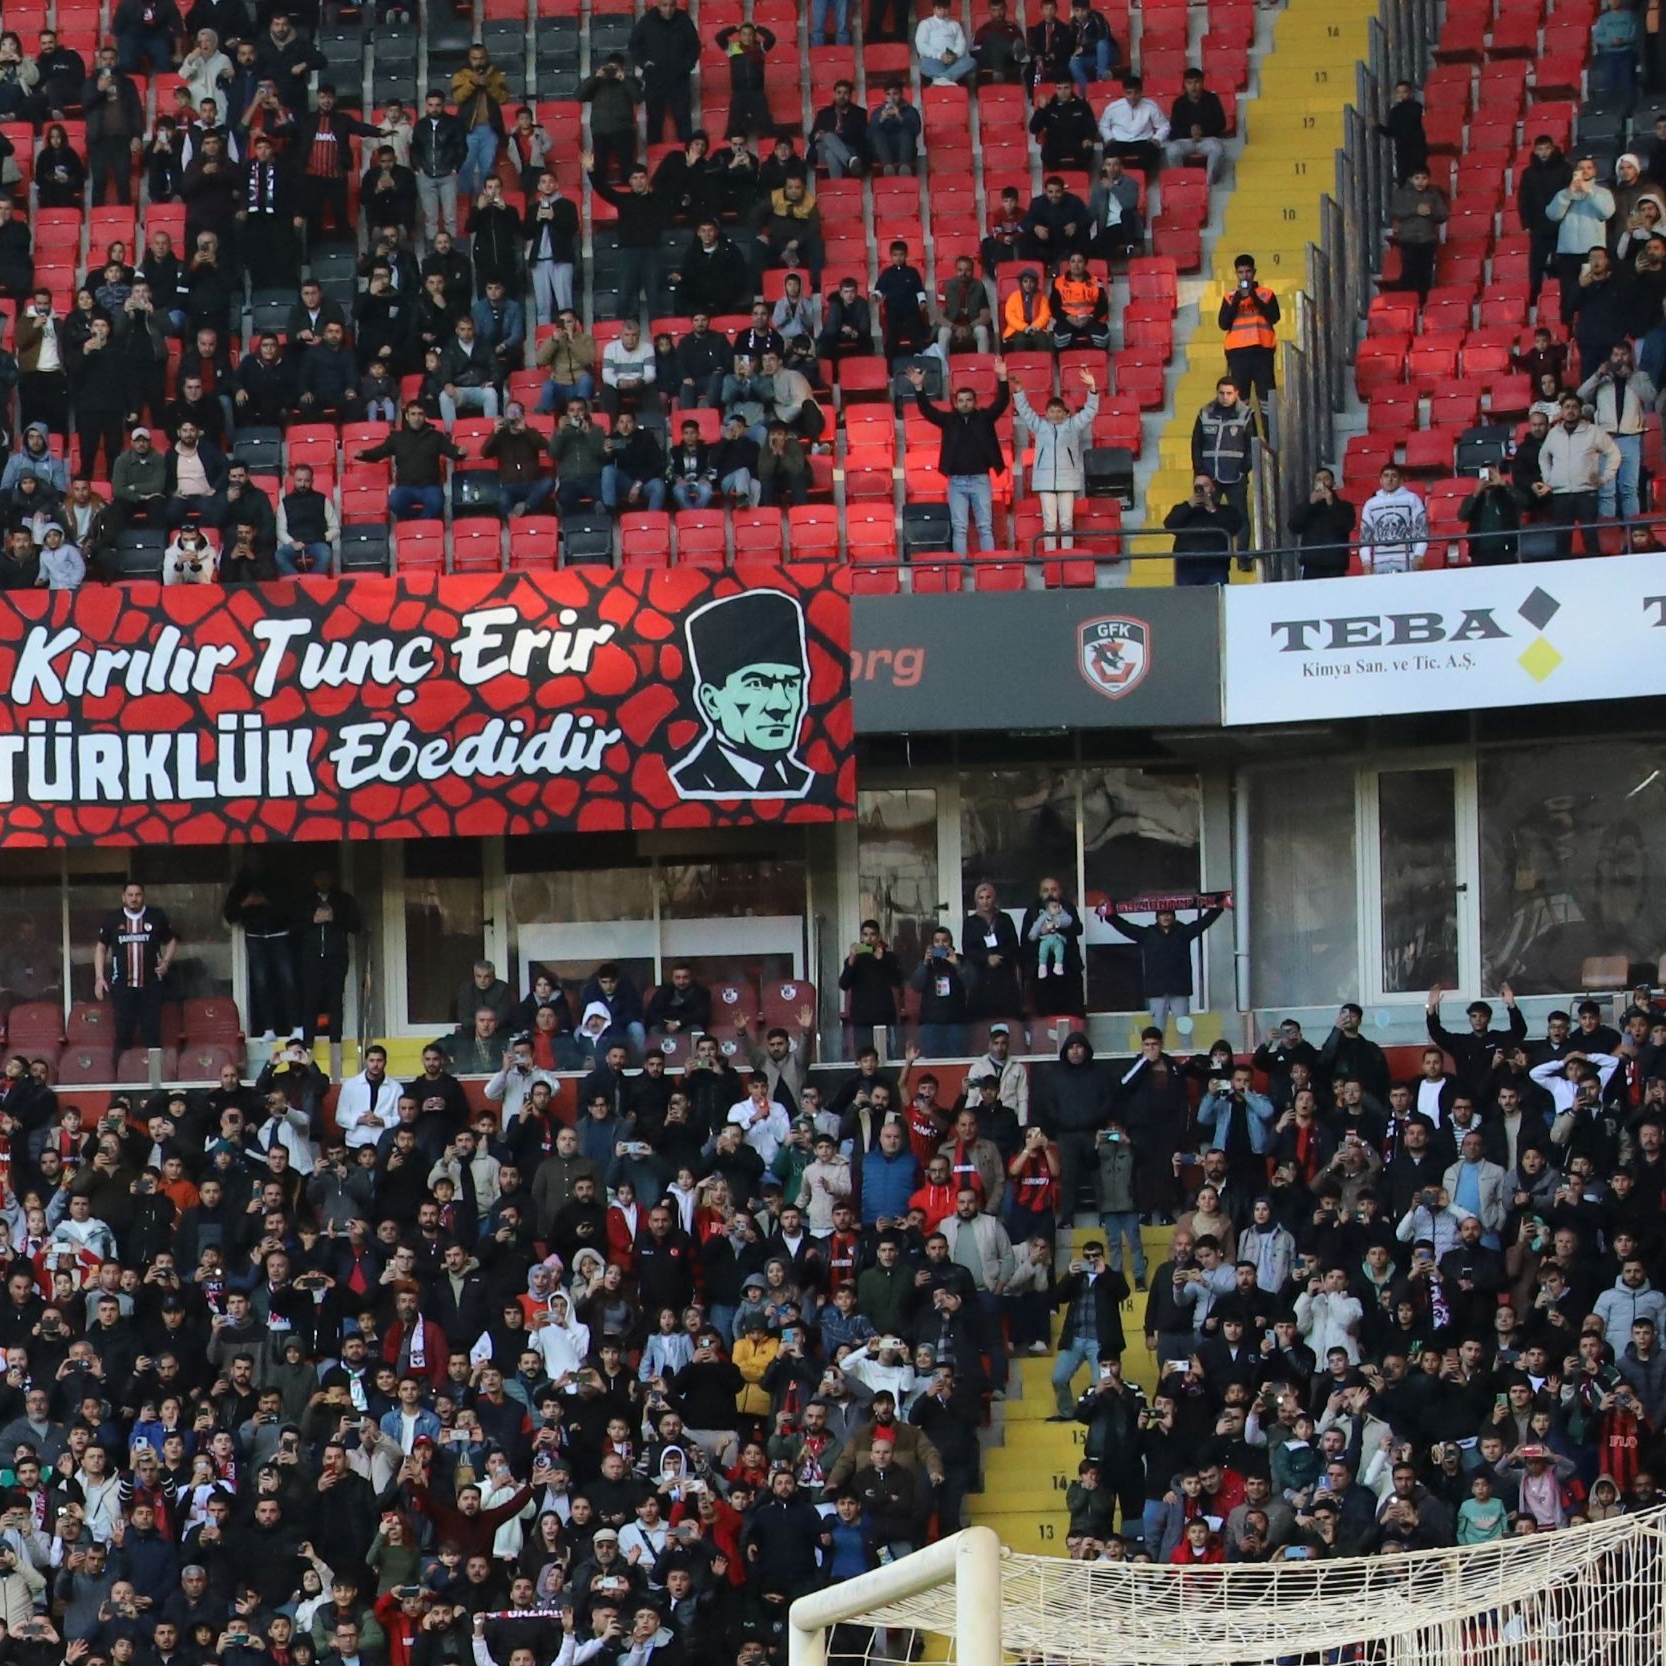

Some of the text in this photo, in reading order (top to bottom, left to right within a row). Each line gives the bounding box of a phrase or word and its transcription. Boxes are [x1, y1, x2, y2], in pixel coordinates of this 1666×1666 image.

[1294, 163, 1306, 175] 11
[1282, 209, 1296, 221] 10
[1273, 253, 1280, 266] 9
[1097, 624, 1129, 638] GFK
[1271, 607, 1513, 652] TEBA
[11, 624, 238, 705] Kırılır
[253, 618, 434, 706] Tunç
[451, 606, 616, 686] Erir
[1302, 661, 1351, 683] Kimya
[1356, 658, 1388, 678] San.
[1393, 660, 1409, 675] ve
[1414, 656, 1442, 674] Tic.
[327, 711, 622, 790] Ebedidir
[1072, 1428, 1086, 1446] 15
[1039, 1524, 1055, 1541] 13
